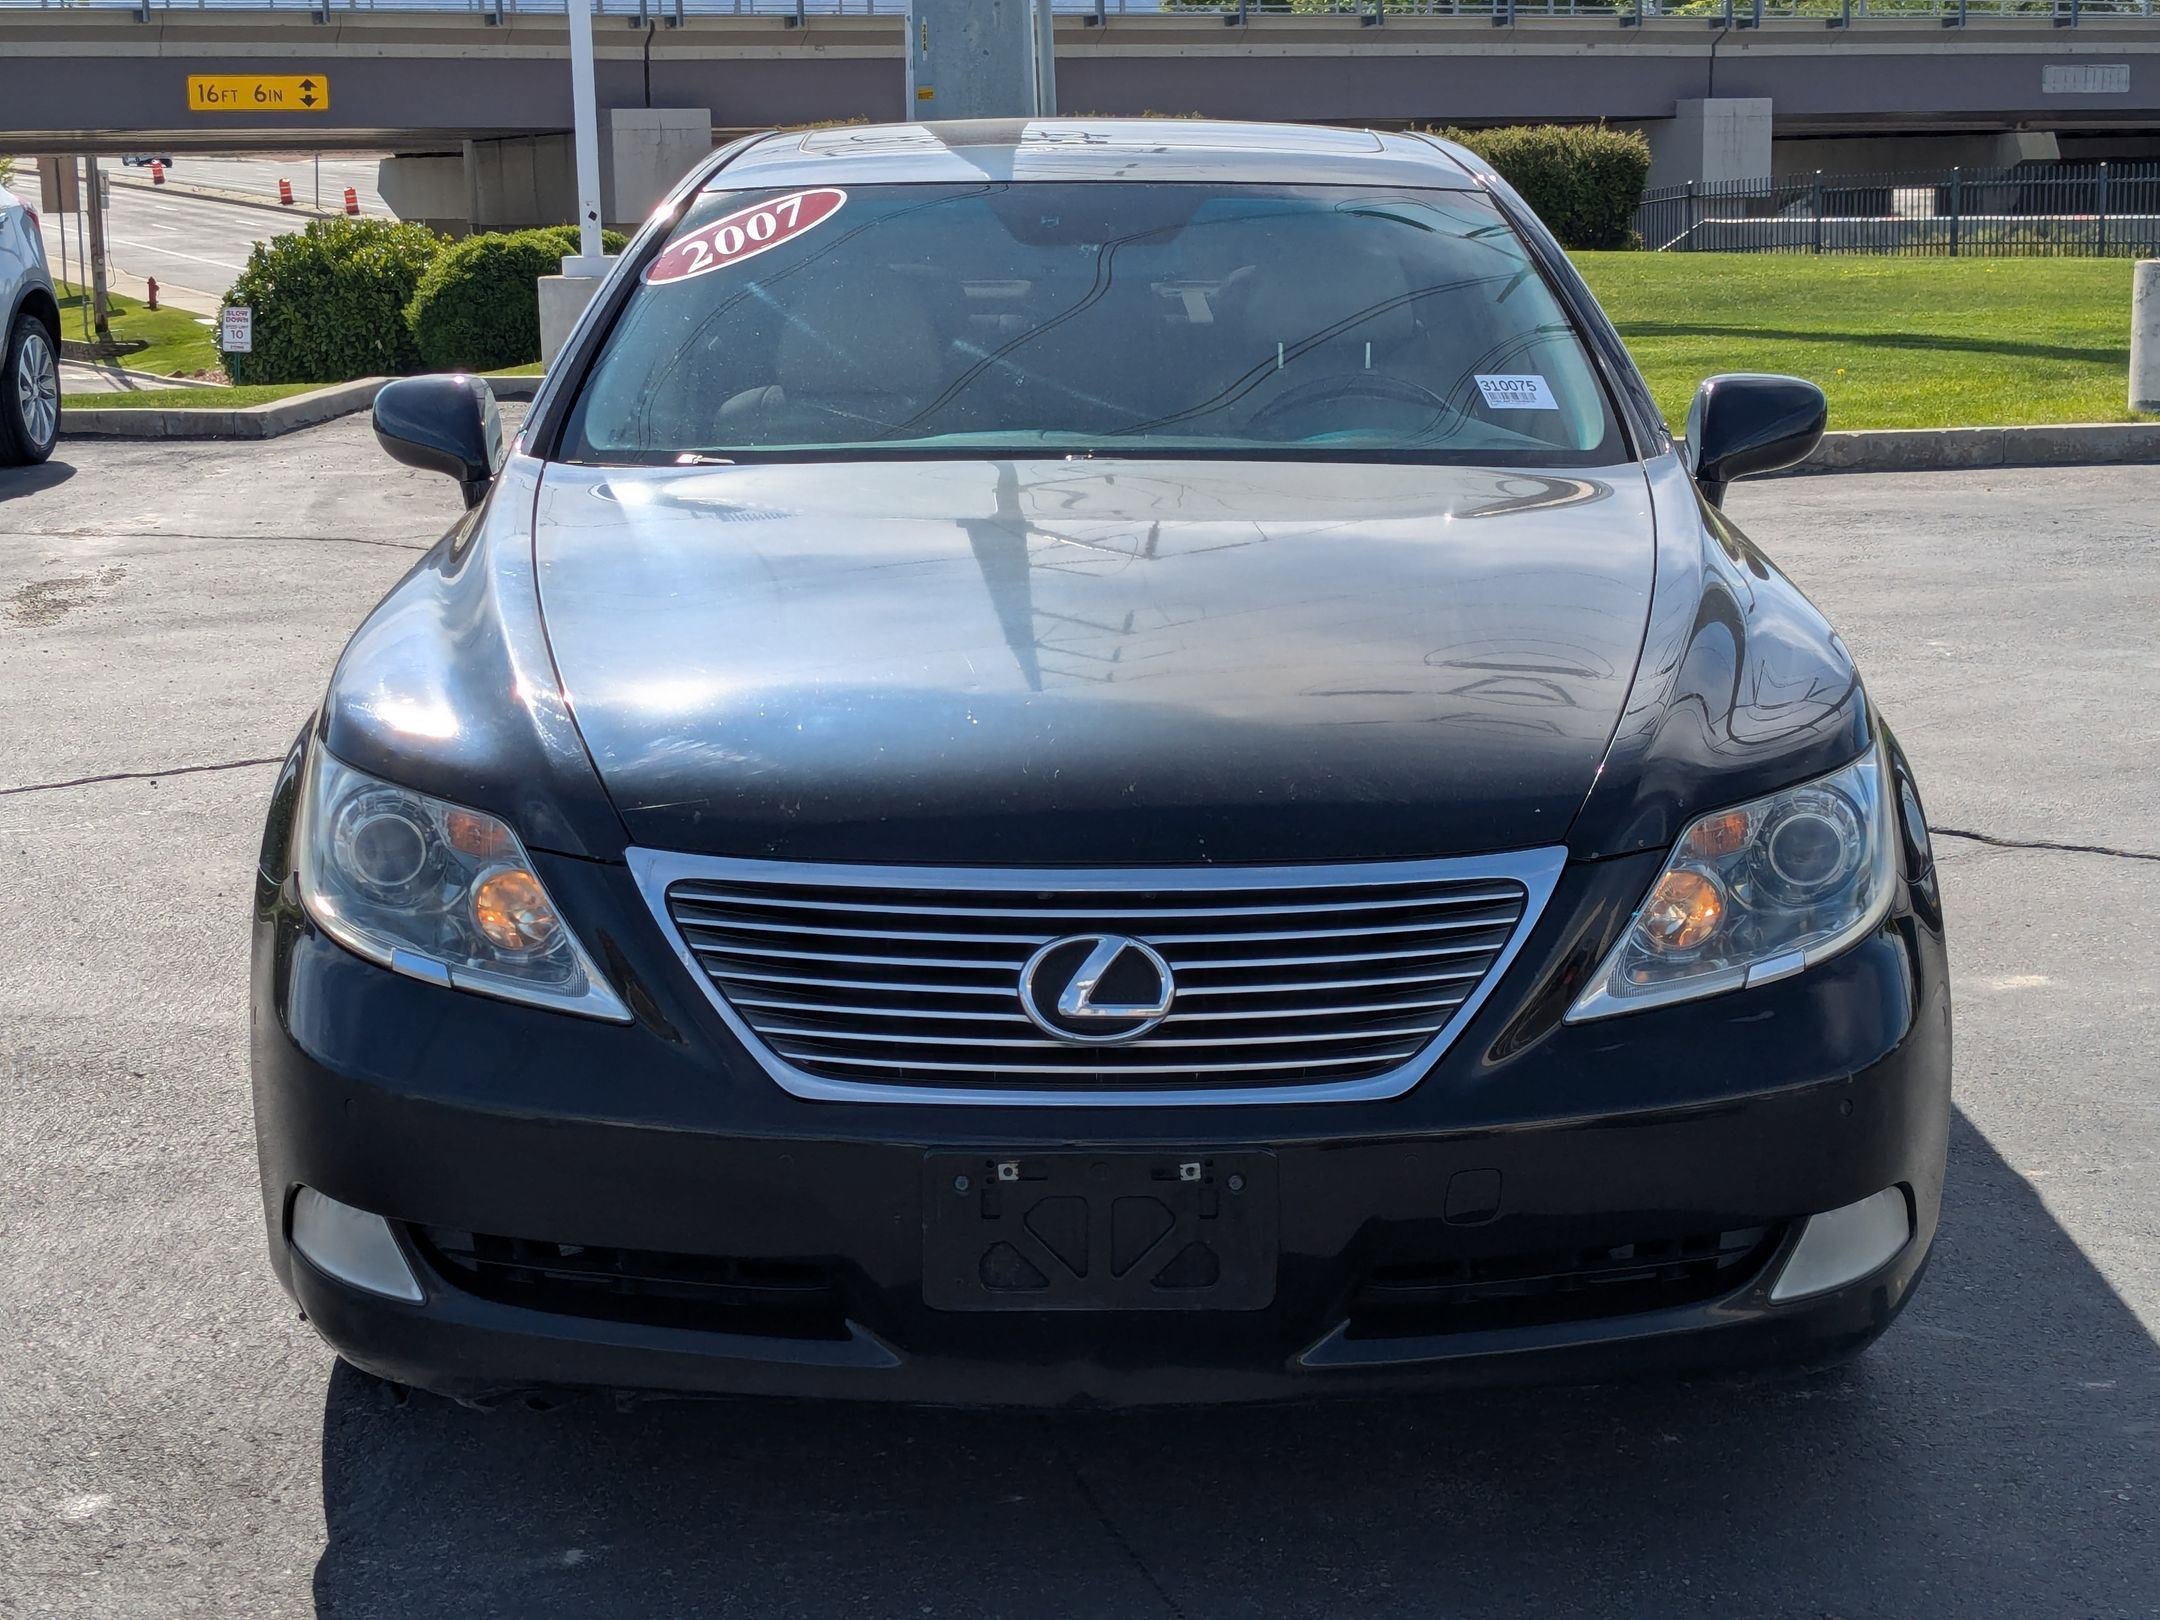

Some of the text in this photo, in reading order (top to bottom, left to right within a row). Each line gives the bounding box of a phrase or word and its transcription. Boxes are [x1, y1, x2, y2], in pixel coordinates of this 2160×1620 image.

[198, 84, 283, 103] 16FT 6IN
[681, 195, 803, 274] 2007
[231, 330, 244, 339] 10
[1480, 380, 1537, 392] 310075
